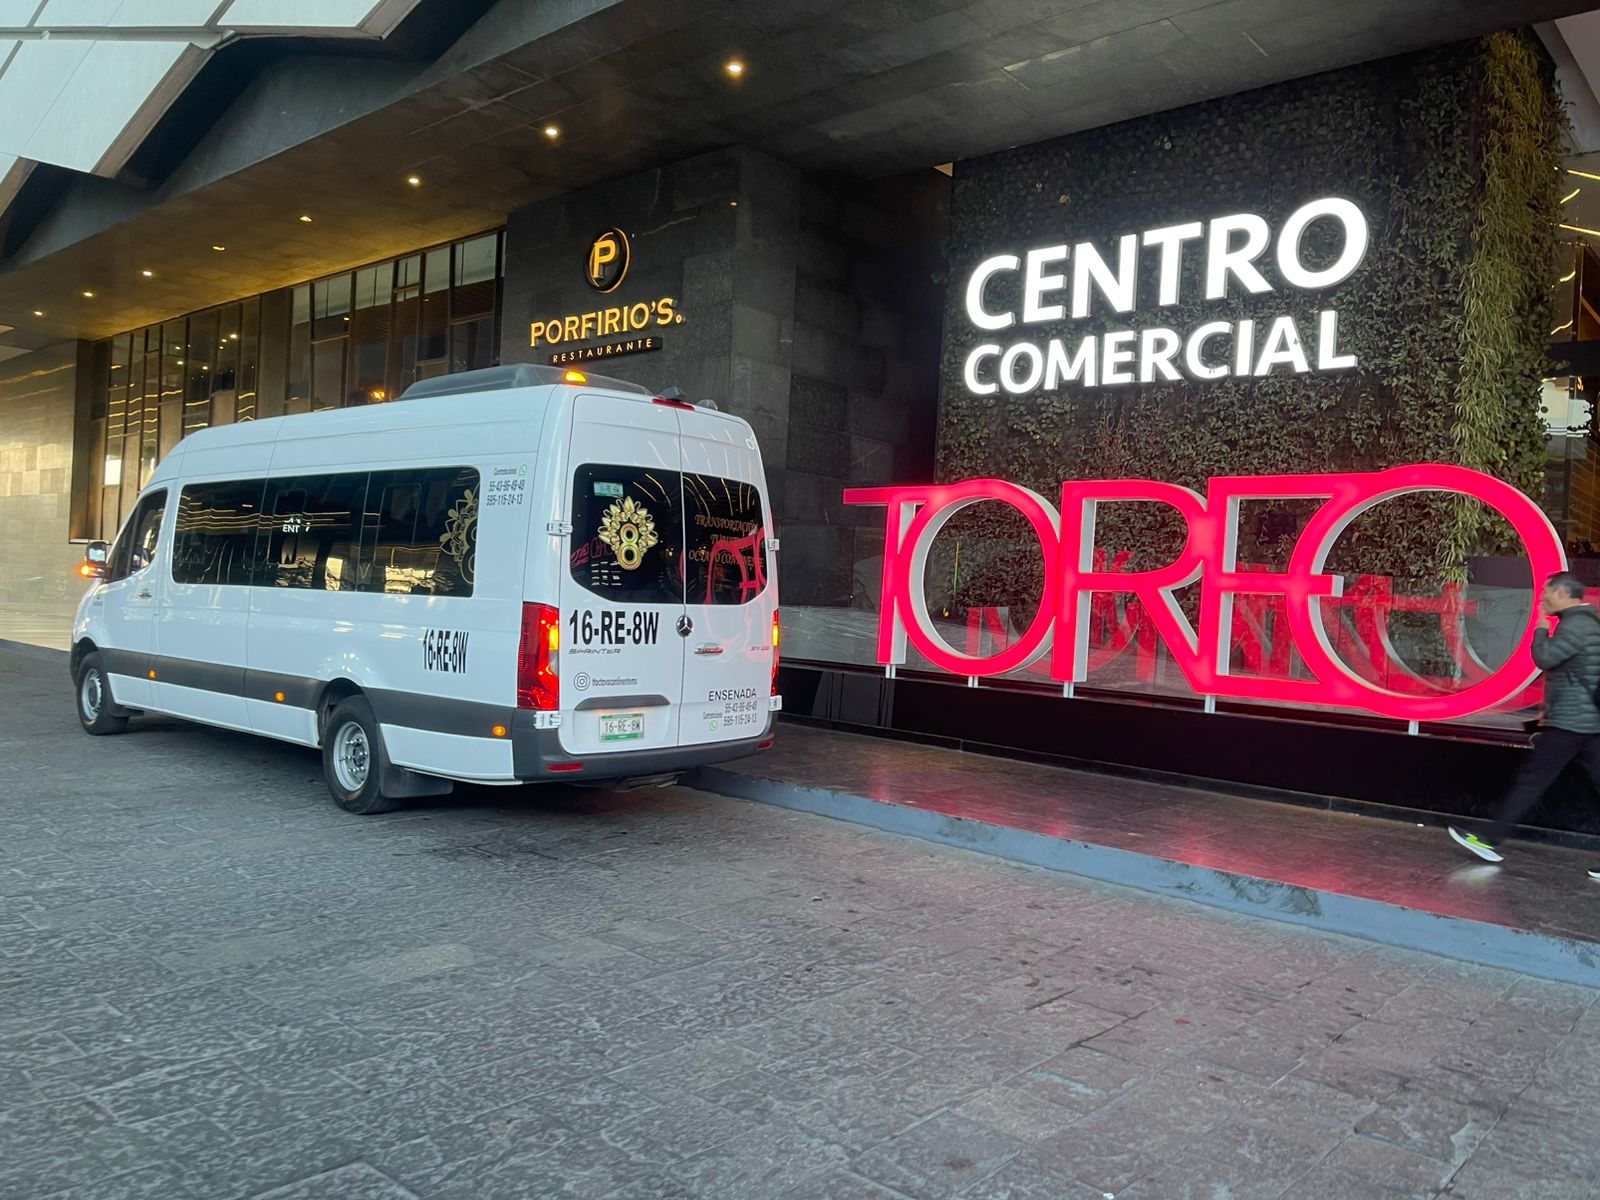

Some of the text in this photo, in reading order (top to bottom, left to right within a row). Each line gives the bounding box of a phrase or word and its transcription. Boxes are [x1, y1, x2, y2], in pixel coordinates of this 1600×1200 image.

[592, 239, 616, 279] P
[965, 197, 1370, 331] CENTRO
[552, 338, 653, 364] RESTAURANTE
[964, 310, 1358, 397] COMERCIAL
[688, 549, 720, 563] OCTAO
[843, 463, 1567, 721] TOREO
[569, 609, 660, 645] 16-RE-8W
[422, 628, 470, 674] 16-RE-8W
[708, 688, 757, 702] ENSENADA
[604, 719, 641, 733] 16-RE-8W
